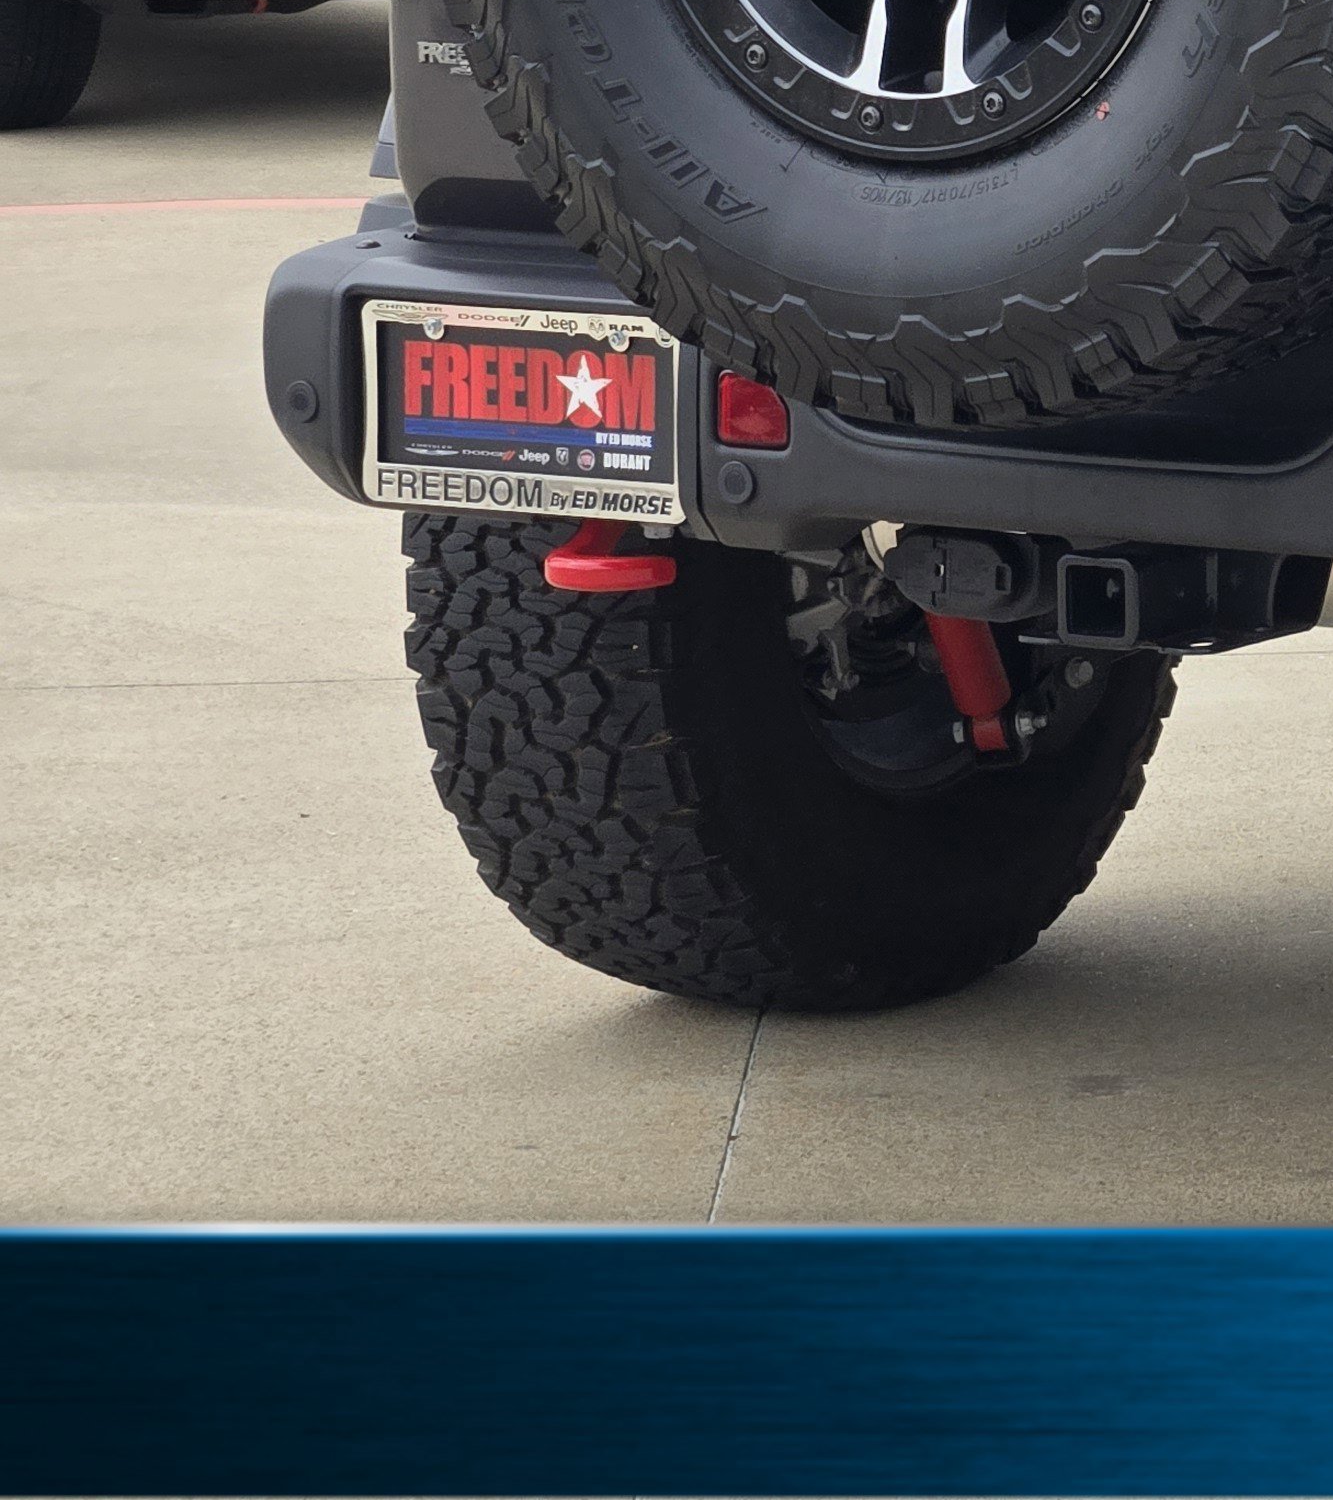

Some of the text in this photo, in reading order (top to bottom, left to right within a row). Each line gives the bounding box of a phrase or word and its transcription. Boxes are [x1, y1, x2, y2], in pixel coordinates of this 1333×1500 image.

[376, 302, 645, 333] CHRYSLER DODGE Jeep RAM
[404, 339, 657, 432] FREEDOM
[518, 448, 551, 465] Jeep
[603, 451, 653, 472] DURANT
[376, 468, 674, 517] FREEDOM By ED MORSE
